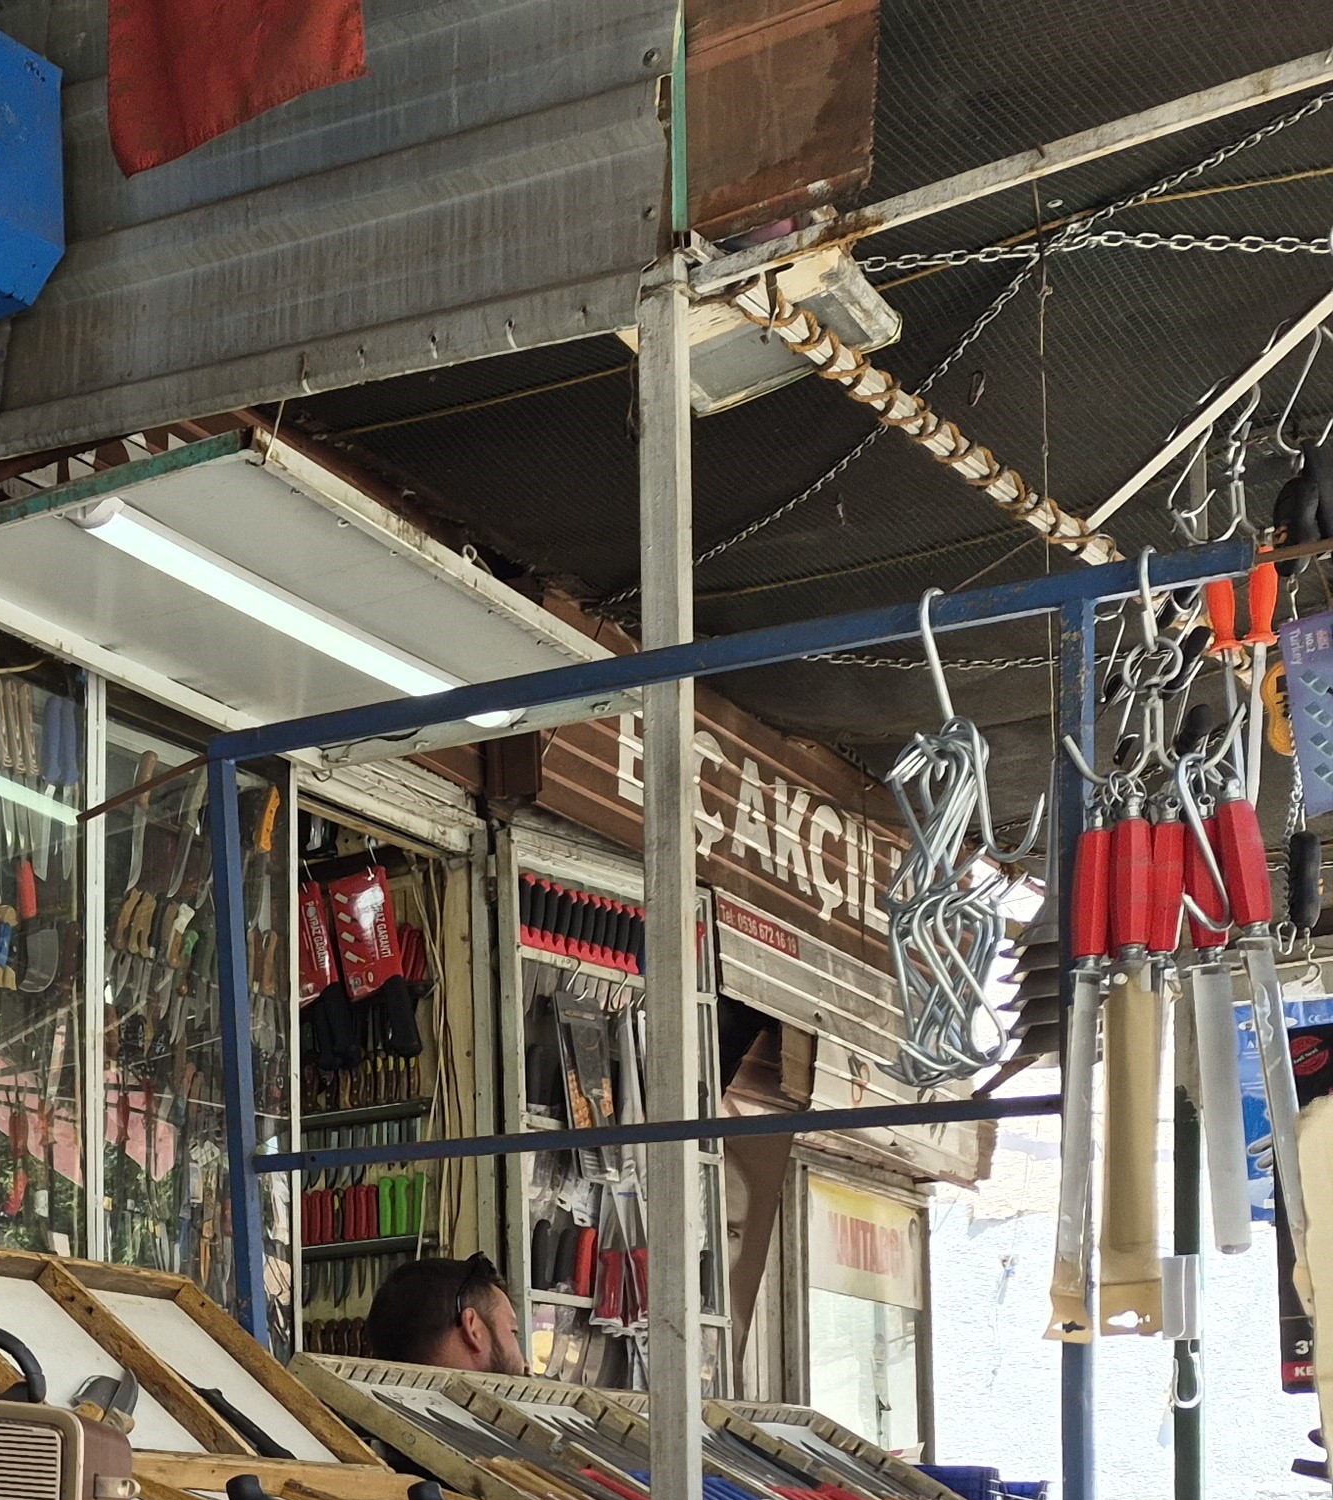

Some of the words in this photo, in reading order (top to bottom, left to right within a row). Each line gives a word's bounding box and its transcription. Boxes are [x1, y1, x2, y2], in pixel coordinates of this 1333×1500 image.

[737, 913, 758, 937] 0536
[758, 922, 775, 944] 672
[775, 930, 786, 949] 16
[1295, 1365, 1315, 1377] KE
